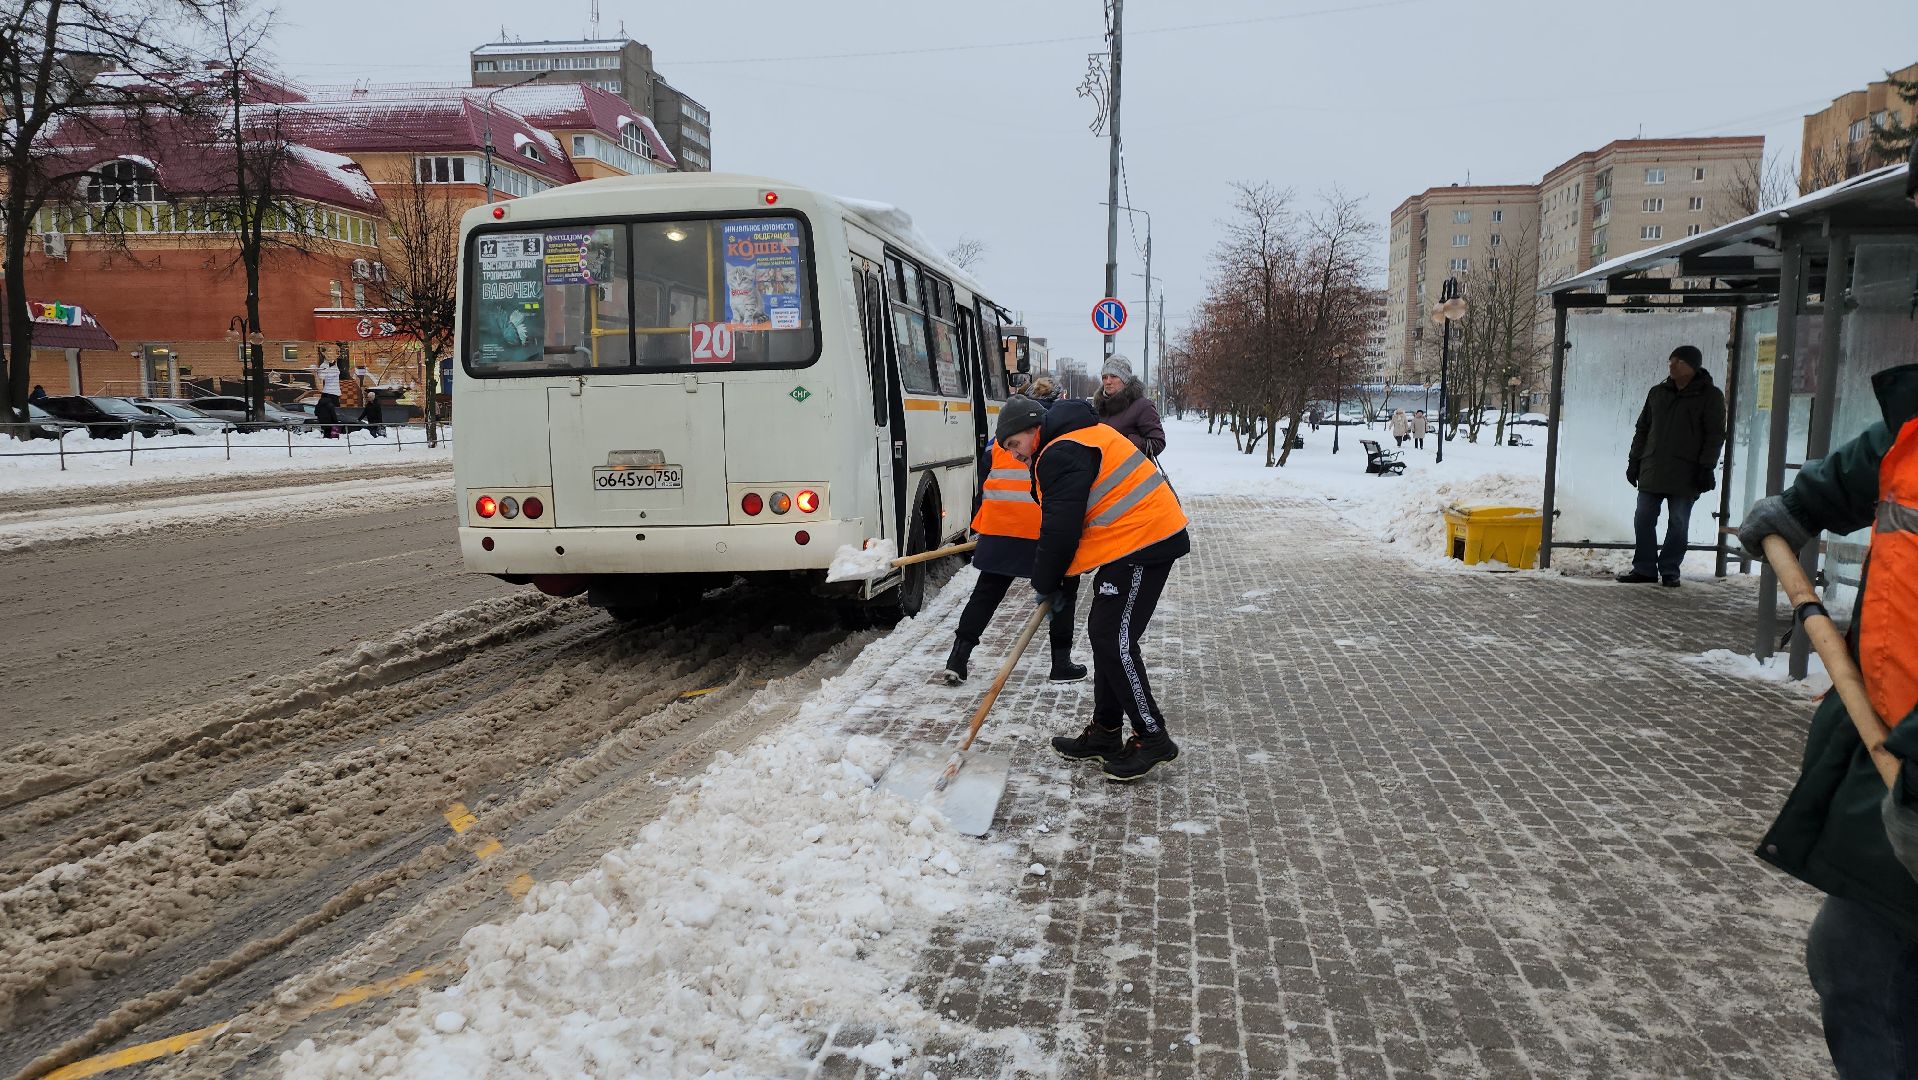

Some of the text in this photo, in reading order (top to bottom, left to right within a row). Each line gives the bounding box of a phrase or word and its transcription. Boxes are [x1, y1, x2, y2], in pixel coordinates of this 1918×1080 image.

[482, 244, 495, 254] 17
[527, 242, 536, 252] 3
[482, 261, 513, 270] ВЫСТАВКА
[514, 259, 537, 269] ЖИВЫХ
[482, 270, 522, 280] ТРОПИЧЕСКИХ
[482, 281, 537, 300] БАБОЧЕК
[693, 323, 731, 358] 20
[792, 388, 808, 398] СНГ
[655, 470, 678, 482] 750
